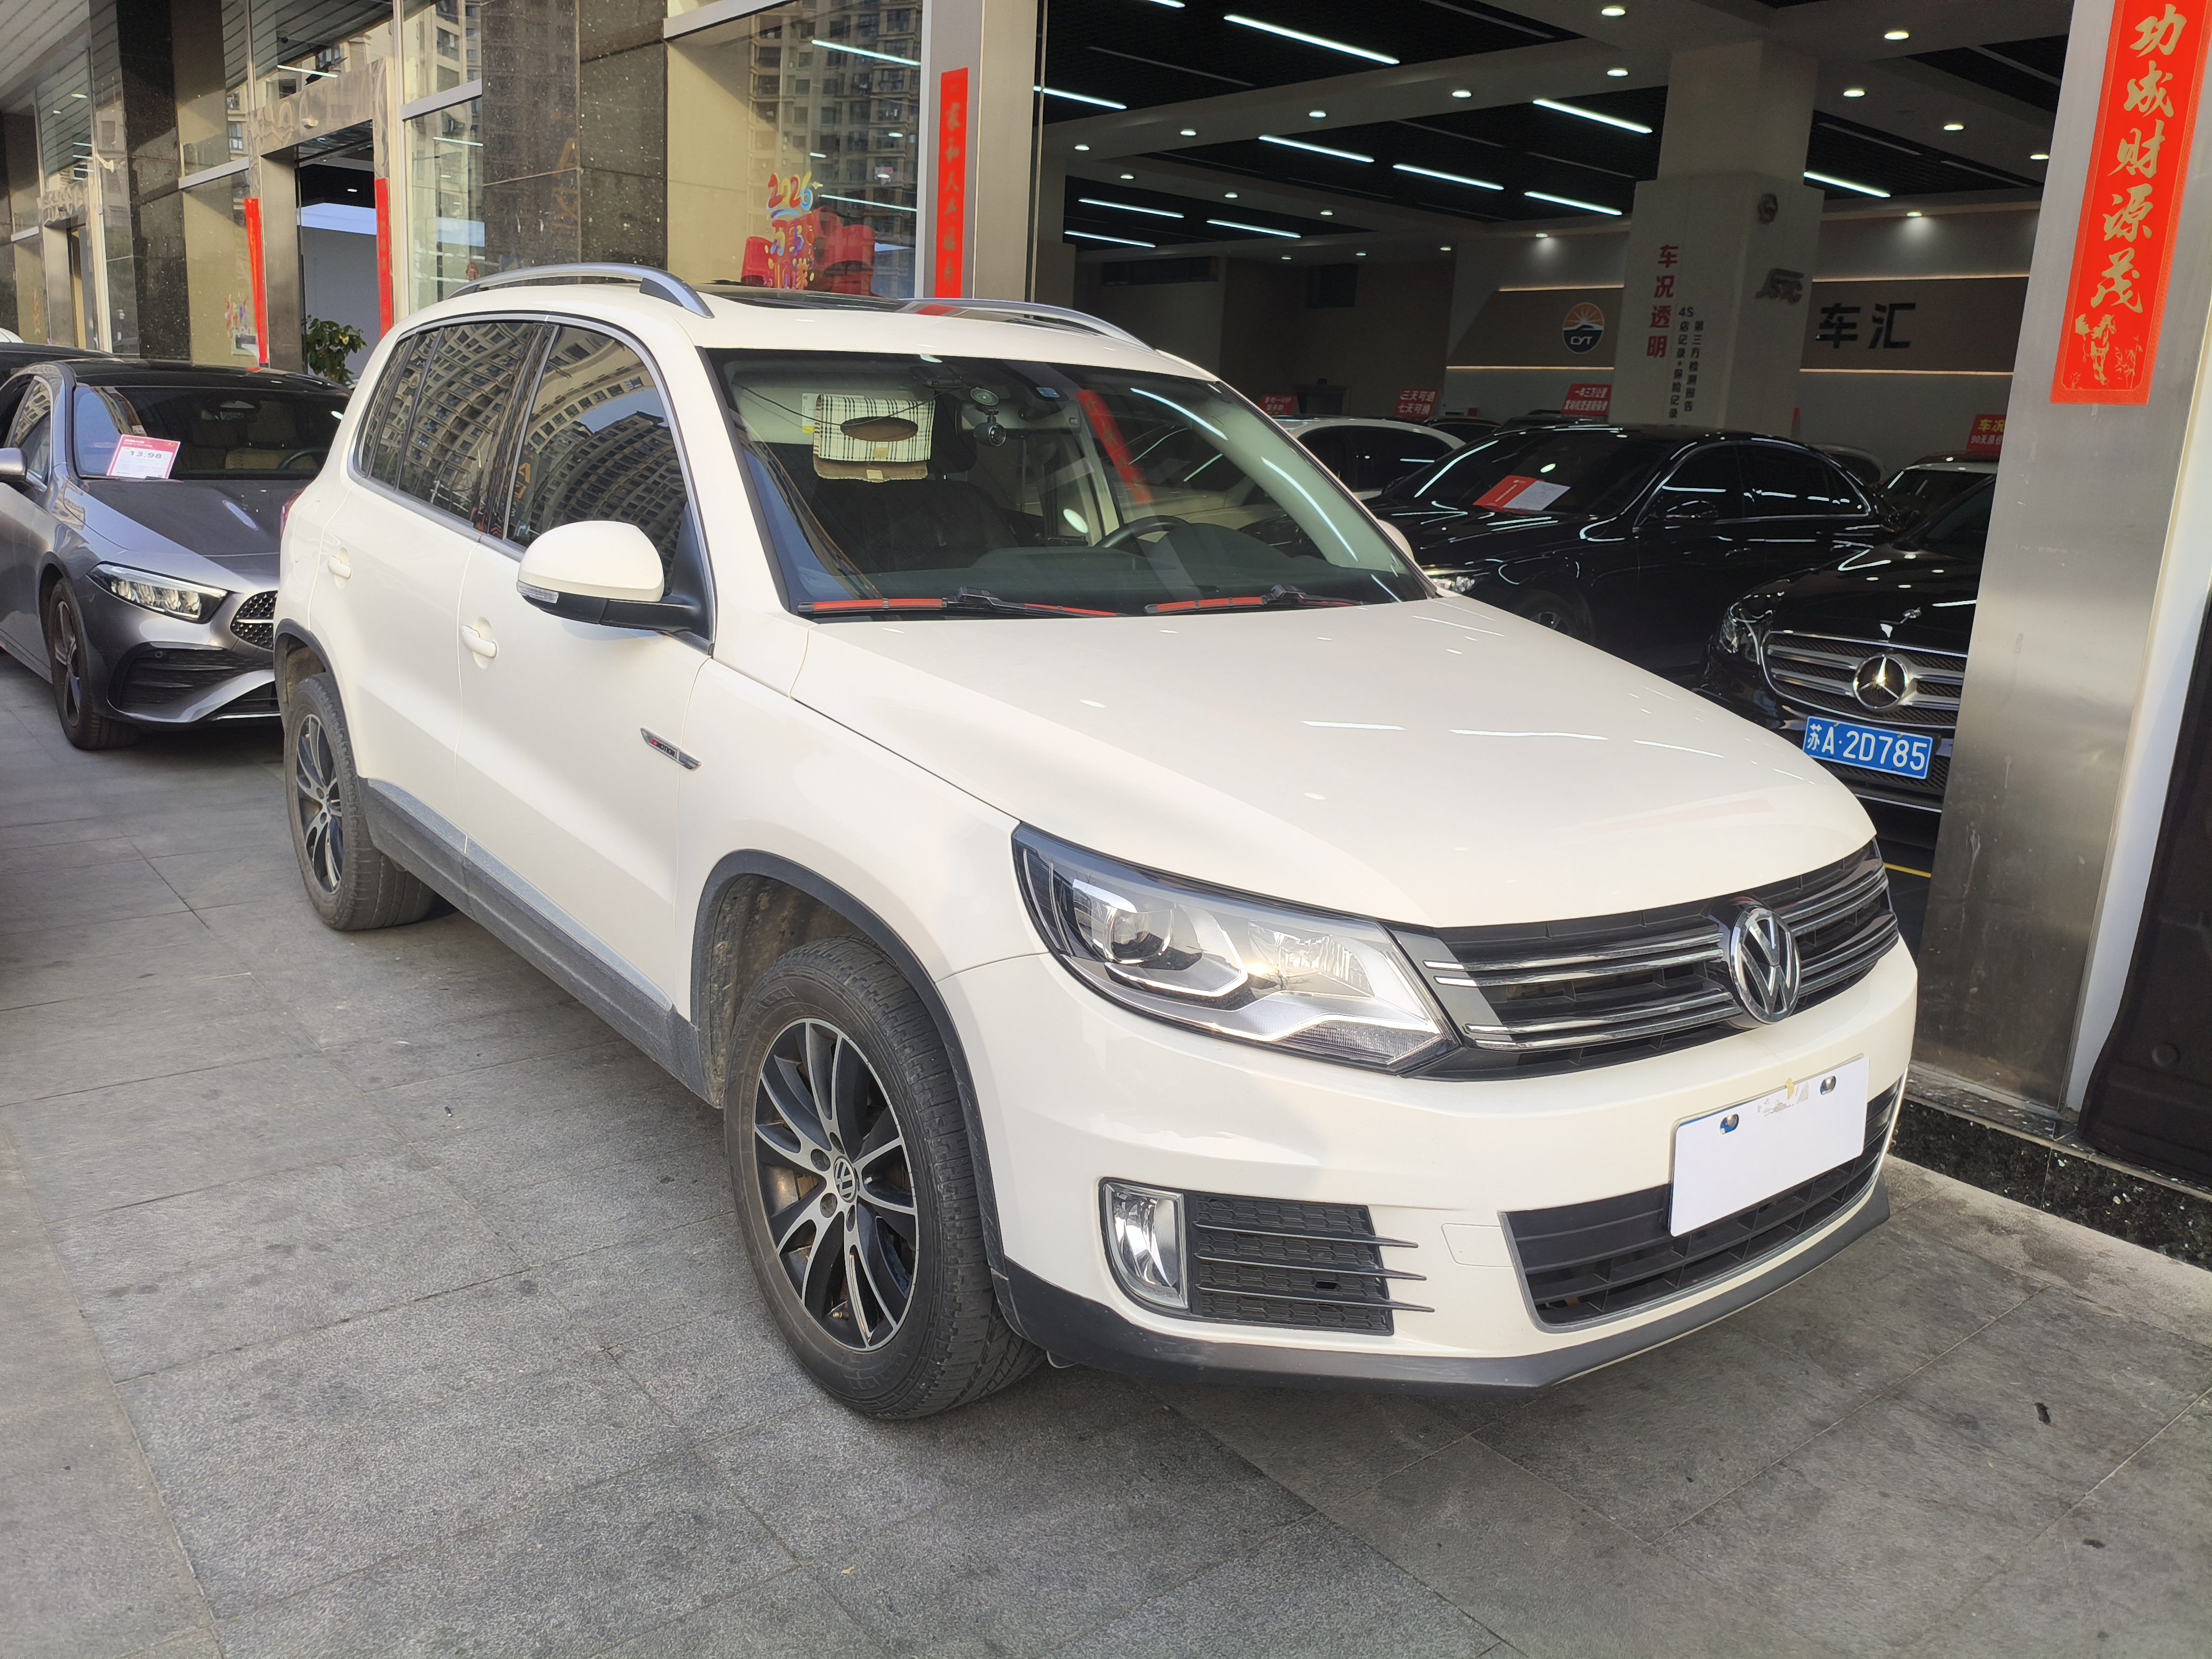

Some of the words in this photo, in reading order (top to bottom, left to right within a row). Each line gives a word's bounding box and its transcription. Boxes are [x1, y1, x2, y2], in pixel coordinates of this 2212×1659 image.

[2091, 3, 2187, 314] 功成财源茂
[766, 171, 813, 211] 2026
[770, 219, 804, 258] 万事
[1646, 244, 1679, 359] 车况透明
[1570, 336, 1594, 345] CYT
[1815, 302, 1917, 349] 车汇
[1397, 403, 1431, 415] 七天可换
[1400, 390, 1436, 402] 三天可退
